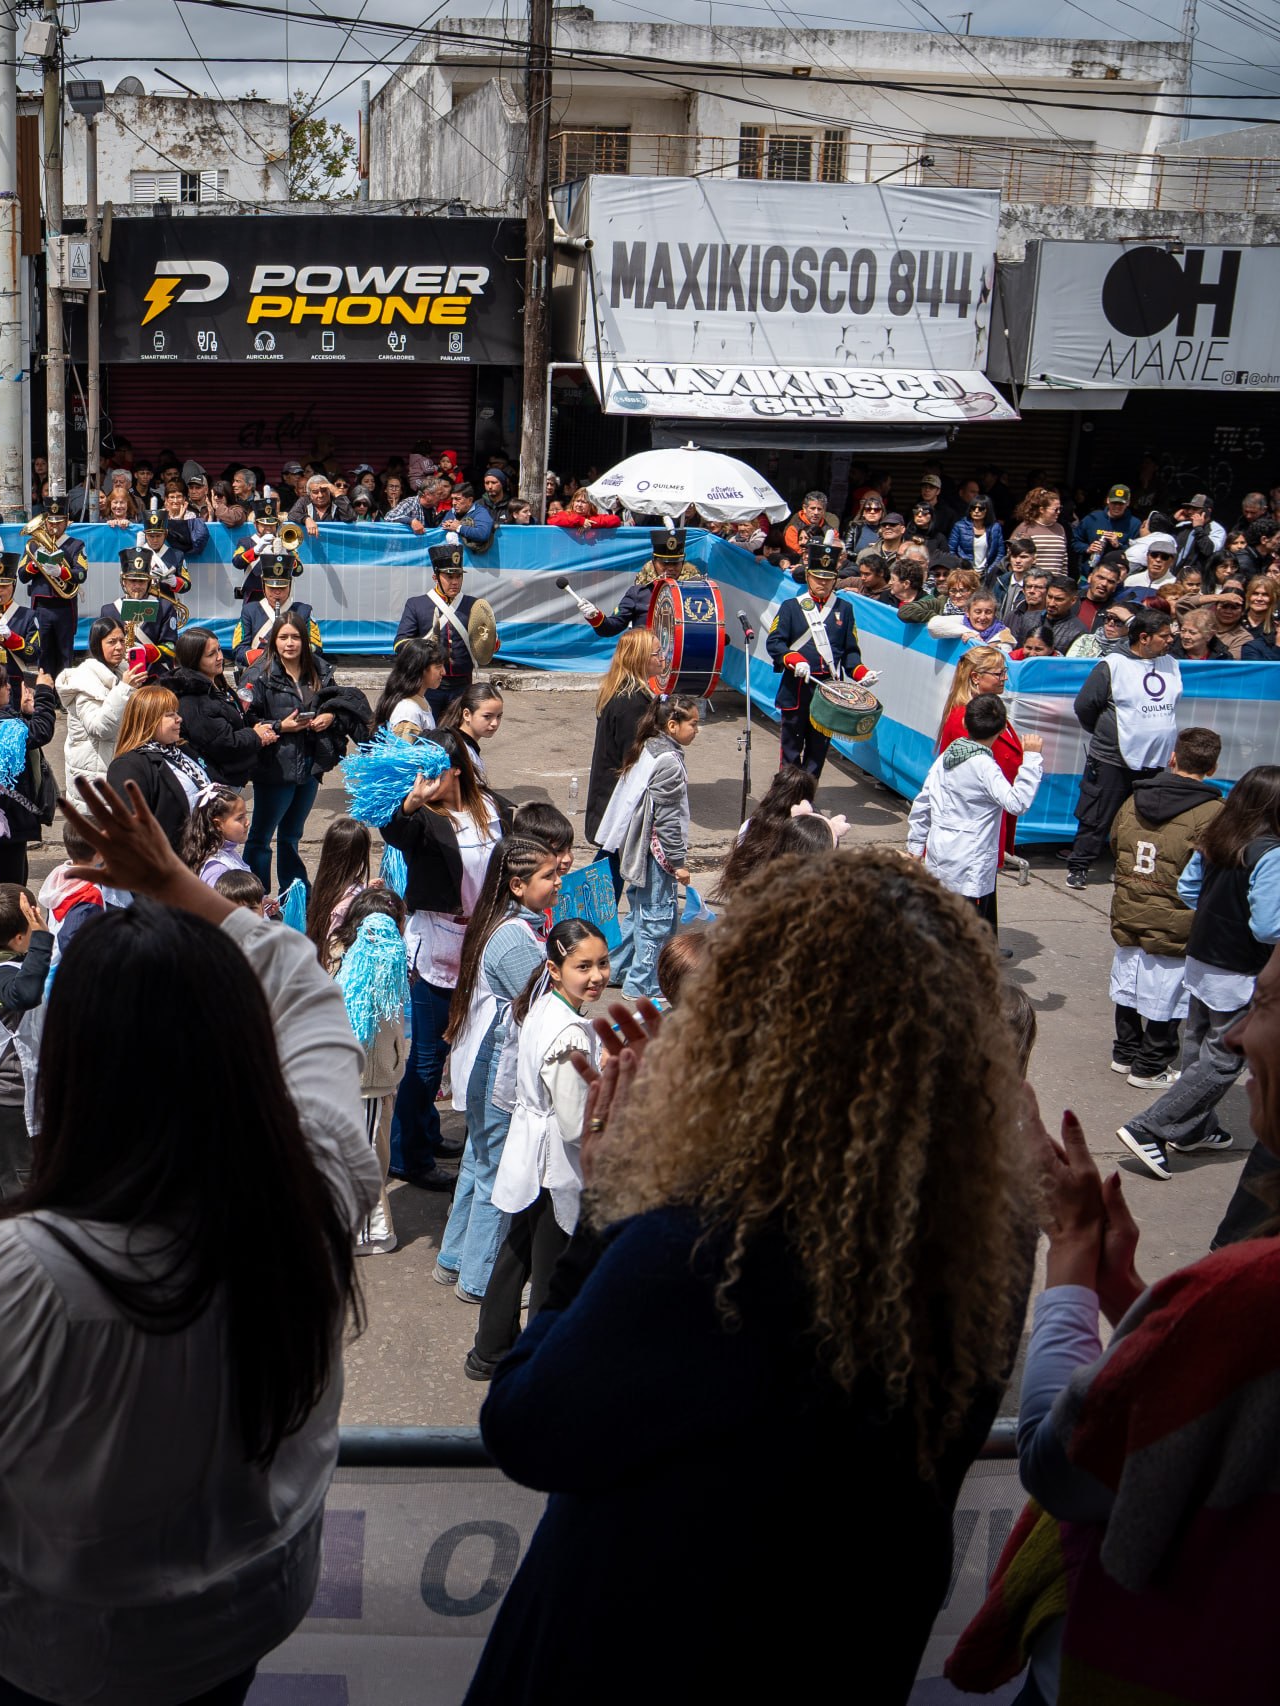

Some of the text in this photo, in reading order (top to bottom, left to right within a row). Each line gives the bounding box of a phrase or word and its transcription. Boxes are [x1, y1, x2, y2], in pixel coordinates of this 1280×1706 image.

[249, 265, 490, 295] POWER
[610, 240, 973, 319] MAXIKIOSCO 844
[1102, 246, 1242, 337] OH
[246, 296, 472, 325] PHONE
[1092, 338, 1230, 382] MARIE
[612, 366, 965, 400] MAXIKIOSCO
[751, 396, 843, 418] 844
[652, 483, 686, 491] QUILMES
[707, 491, 744, 500] QUILMES
[694, 601, 702, 613] 7
[1133, 840, 1157, 875] B
